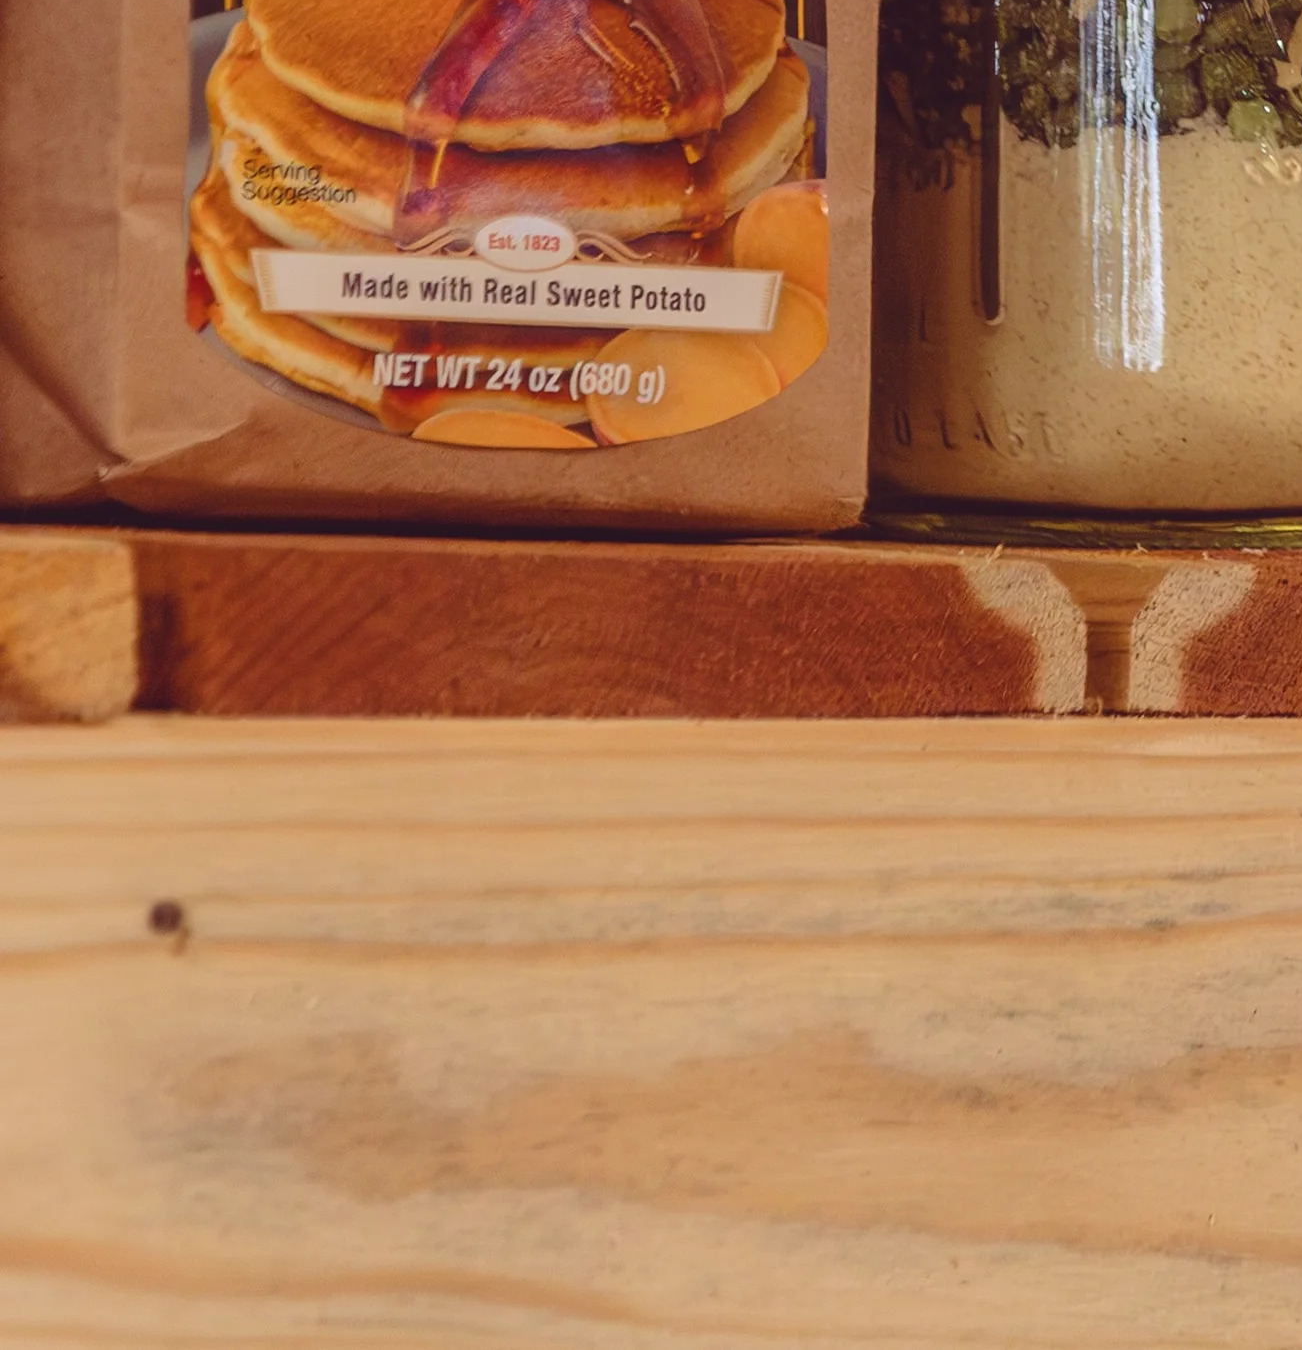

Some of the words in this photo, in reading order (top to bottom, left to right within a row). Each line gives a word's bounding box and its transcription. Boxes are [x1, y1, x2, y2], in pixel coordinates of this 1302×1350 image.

[242, 158, 323, 186] Serving
[241, 181, 359, 207] Suggestion
[487, 232, 517, 251] Est.
[522, 233, 561, 253] 1823
[341, 271, 409, 299] Made
[419, 275, 473, 303] with
[482, 277, 537, 307] Real
[546, 280, 621, 310] Sweet
[630, 284, 707, 313] Potato
[372, 352, 432, 388] NET
[436, 354, 483, 390] WT
[485, 357, 523, 392] 24
[528, 366, 565, 394] oz
[569, 360, 632, 402] (680
[635, 364, 666, 405] g)
